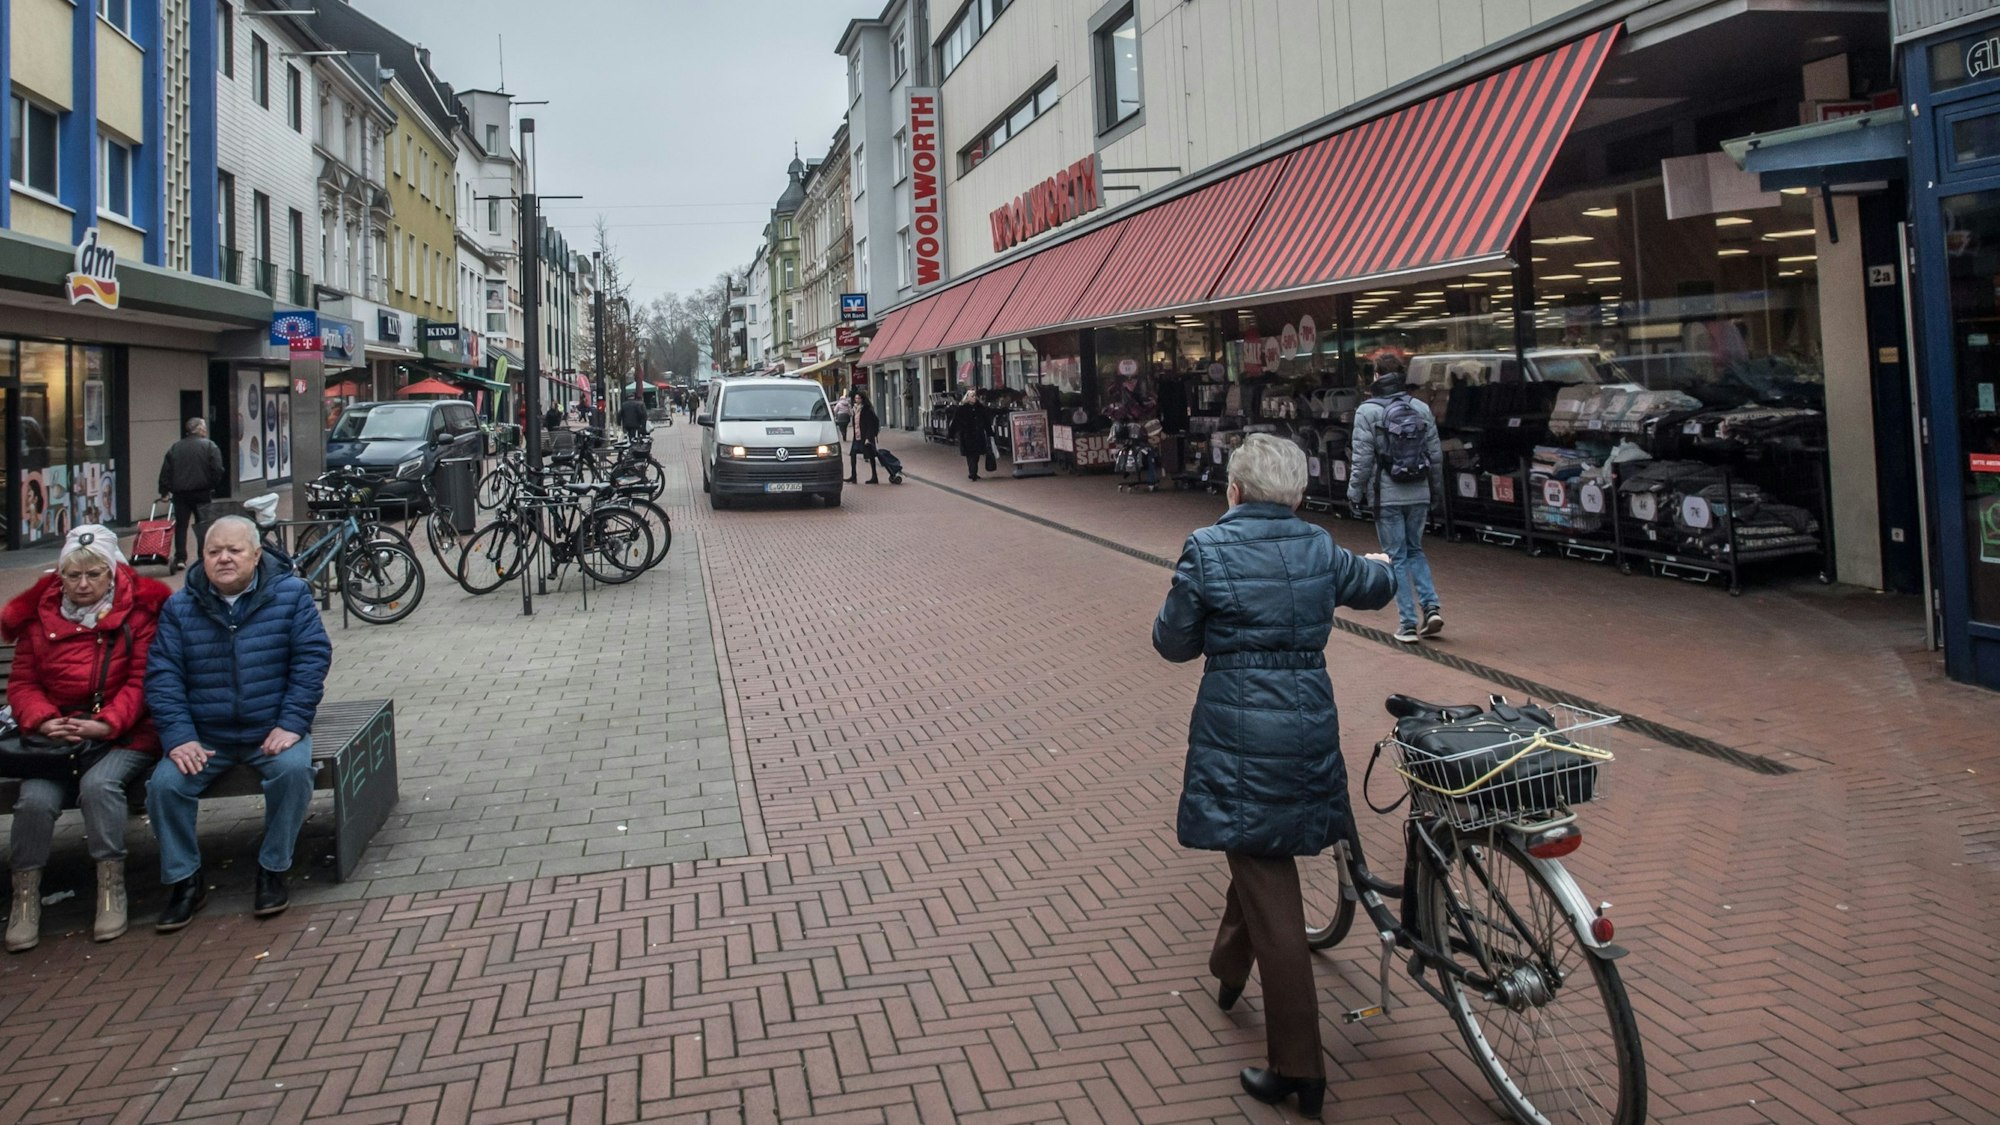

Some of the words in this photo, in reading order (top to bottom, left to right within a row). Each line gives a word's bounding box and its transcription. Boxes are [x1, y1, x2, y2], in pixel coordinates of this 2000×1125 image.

[911, 96, 940, 286] WOOLWORTH
[989, 153, 1097, 253] WOOLWORTH
[82, 231, 115, 279] dm
[1872, 268, 1892, 284] 2a
[427, 326, 457, 337] KIND
[1243, 342, 1262, 364] SALE
